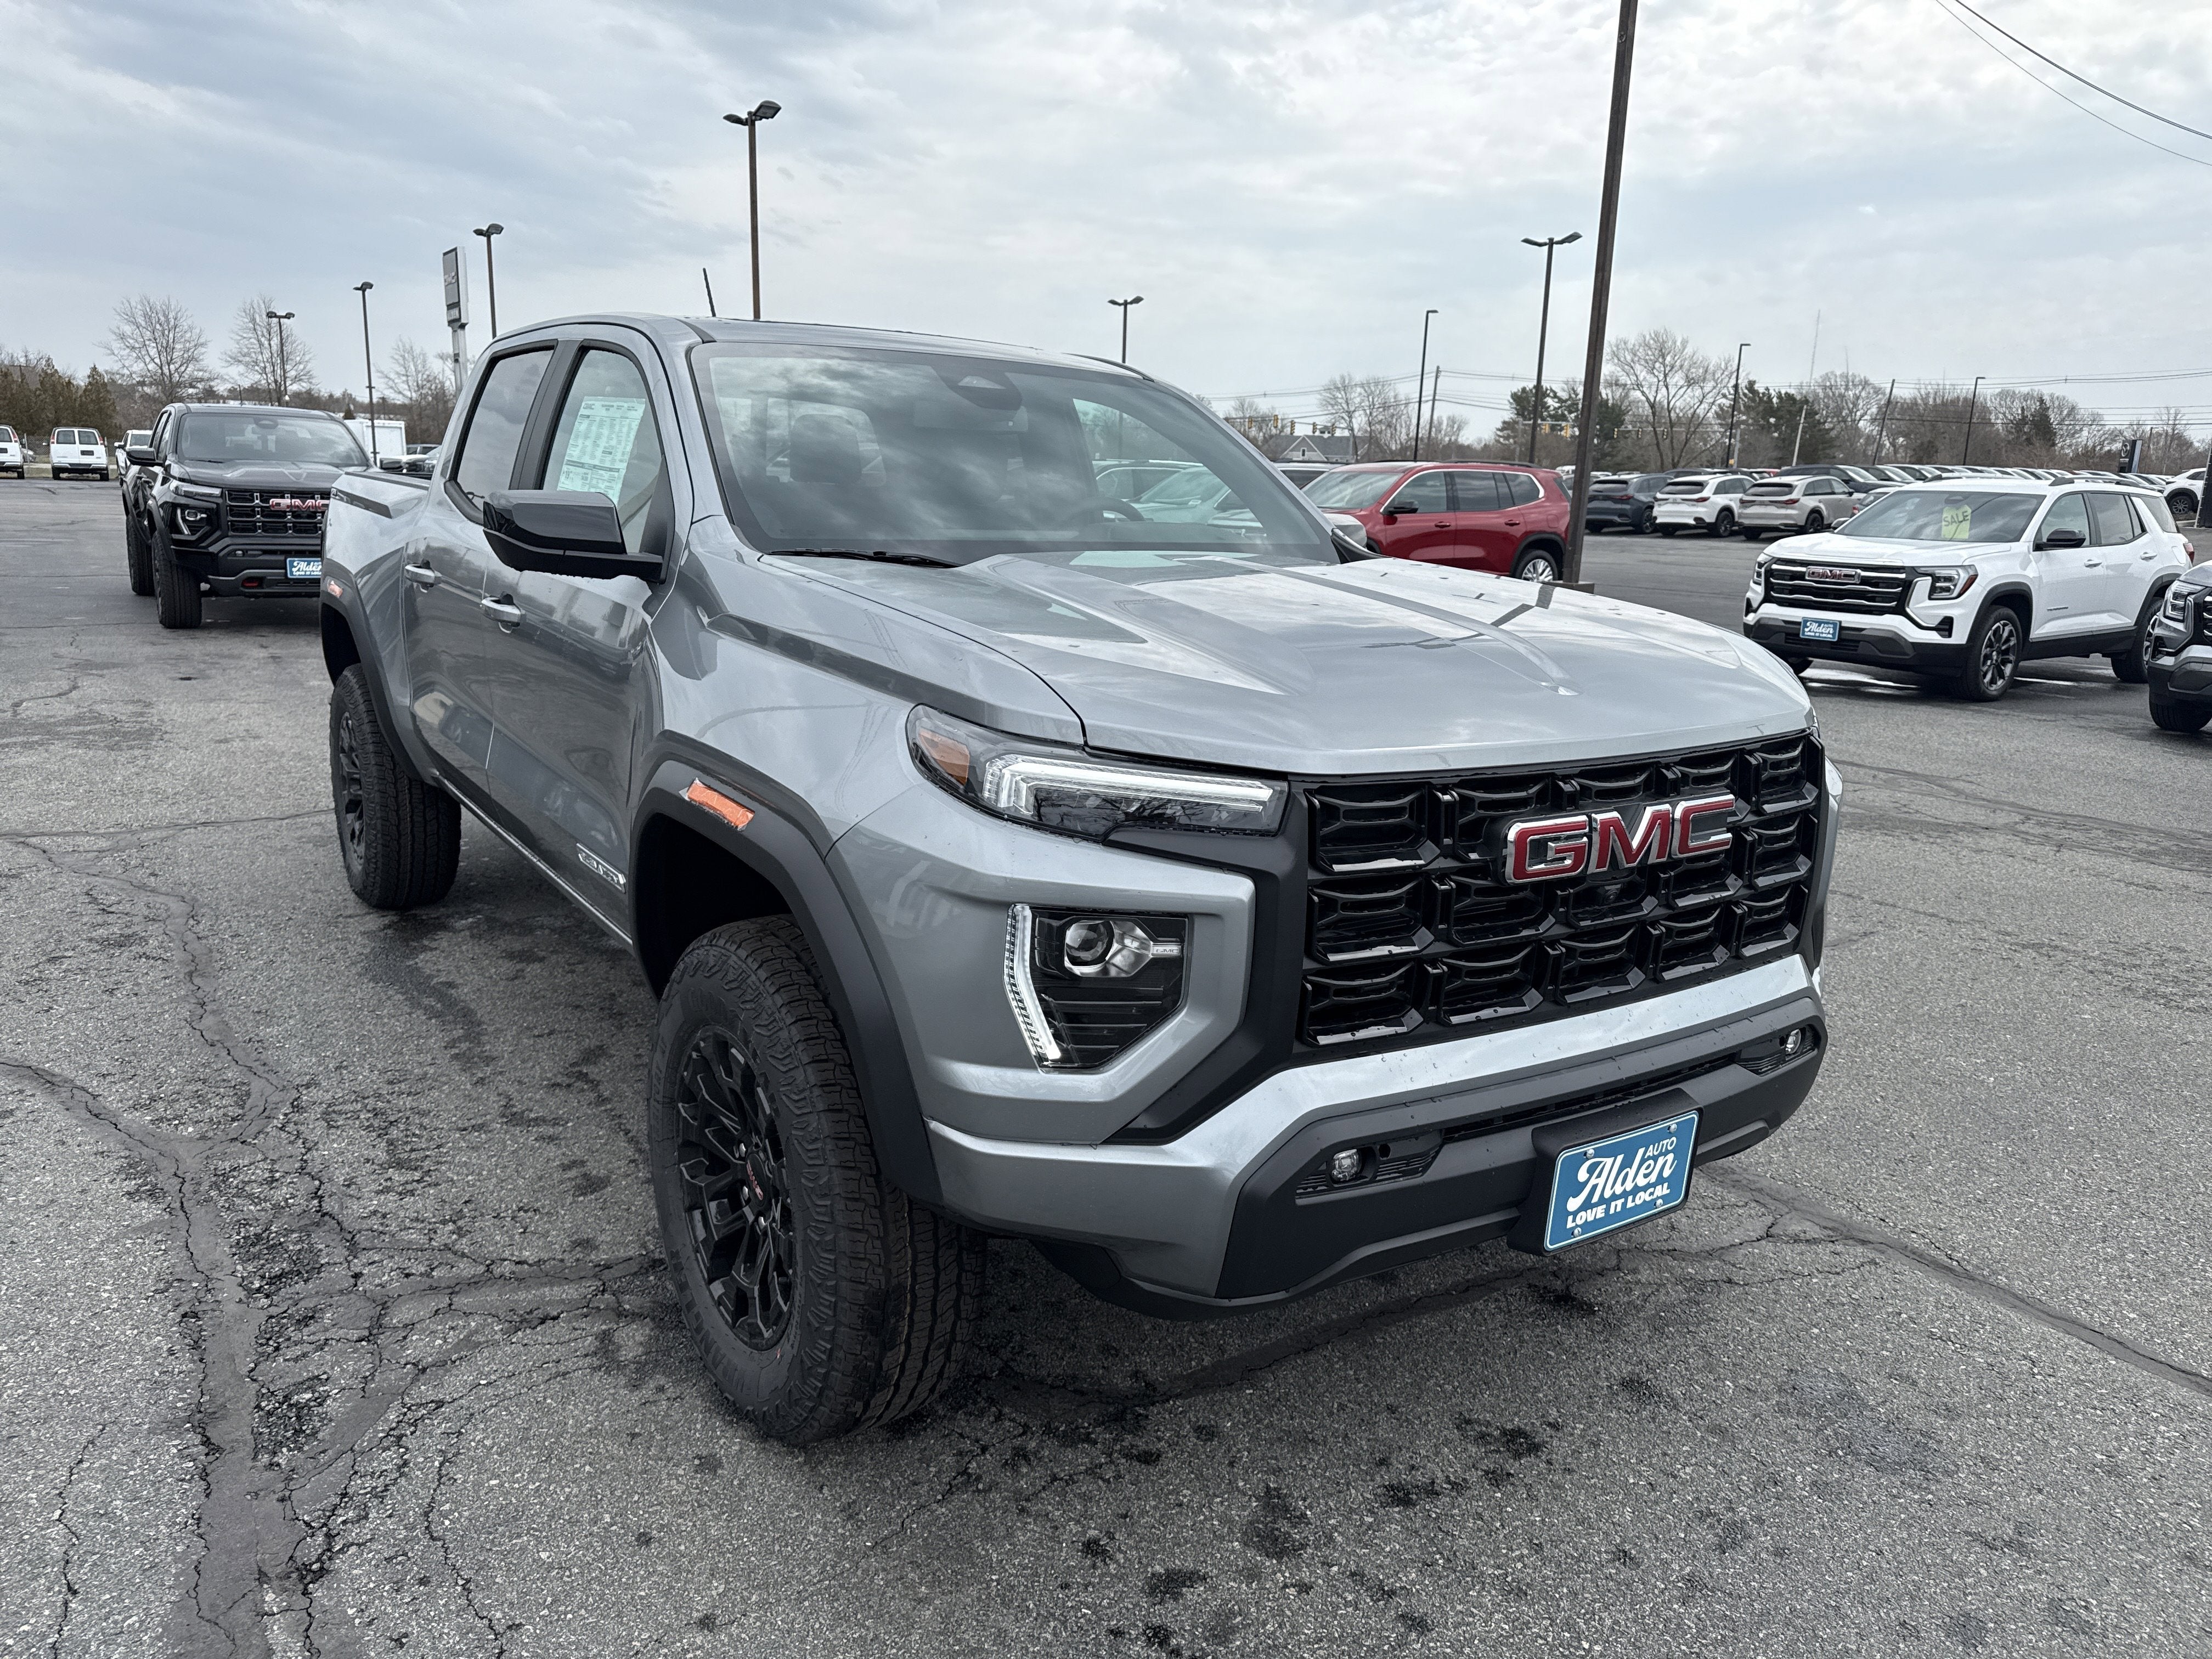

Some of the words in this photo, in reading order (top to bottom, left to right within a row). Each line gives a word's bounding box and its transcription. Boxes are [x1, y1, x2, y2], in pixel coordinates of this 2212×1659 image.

[269, 499, 330, 511] GMC
[1943, 511, 1970, 527] SALE
[292, 561, 321, 571] Alde
[1808, 568, 1855, 580] GMC
[1804, 621, 1834, 634] Alden
[1505, 794, 1735, 884] GMC
[1644, 1136, 1677, 1159] AUTO
[1567, 1147, 1678, 1212] Alden
[1567, 1205, 1605, 1229] LOVE
[1609, 1199, 1624, 1215] IT
[1627, 1182, 1671, 1207] LOCAL
